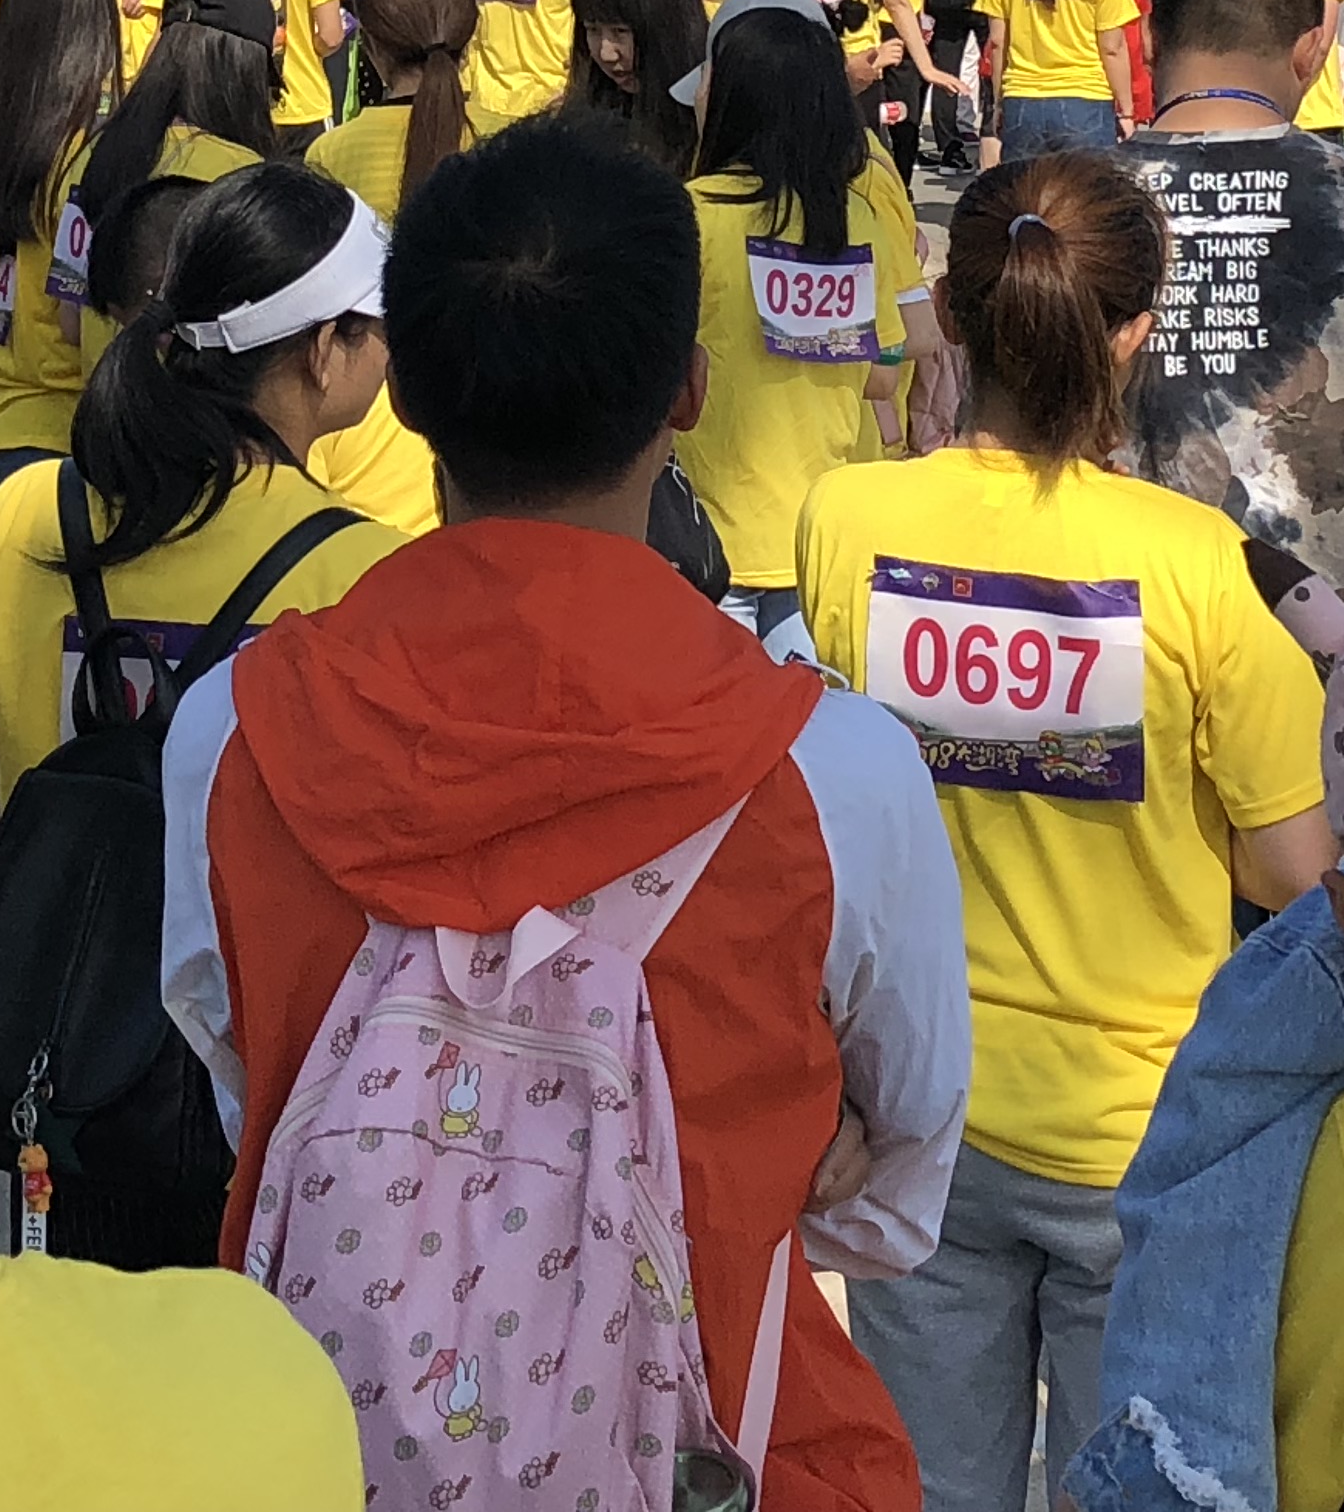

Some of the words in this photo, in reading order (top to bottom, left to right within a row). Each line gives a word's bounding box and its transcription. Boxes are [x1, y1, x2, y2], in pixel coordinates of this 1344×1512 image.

[1188, 170, 1290, 192] CREATING
[1217, 190, 1283, 213] OFTEN
[1195, 237, 1271, 259] THANKS
[1165, 259, 1213, 283] REAM
[1225, 260, 1259, 281] BIG
[766, 269, 855, 319] 0329
[1153, 285, 1199, 306] ORK
[1210, 283, 1261, 304] HARD
[1157, 309, 1193, 330] AKE
[1203, 306, 1261, 328] RISKS
[1141, 332, 1179, 354] TAY
[1190, 328, 1271, 352] HUMBLE
[1164, 354, 1189, 378] BE
[1200, 352, 1237, 376] YOU
[902, 616, 1102, 716] 0697
